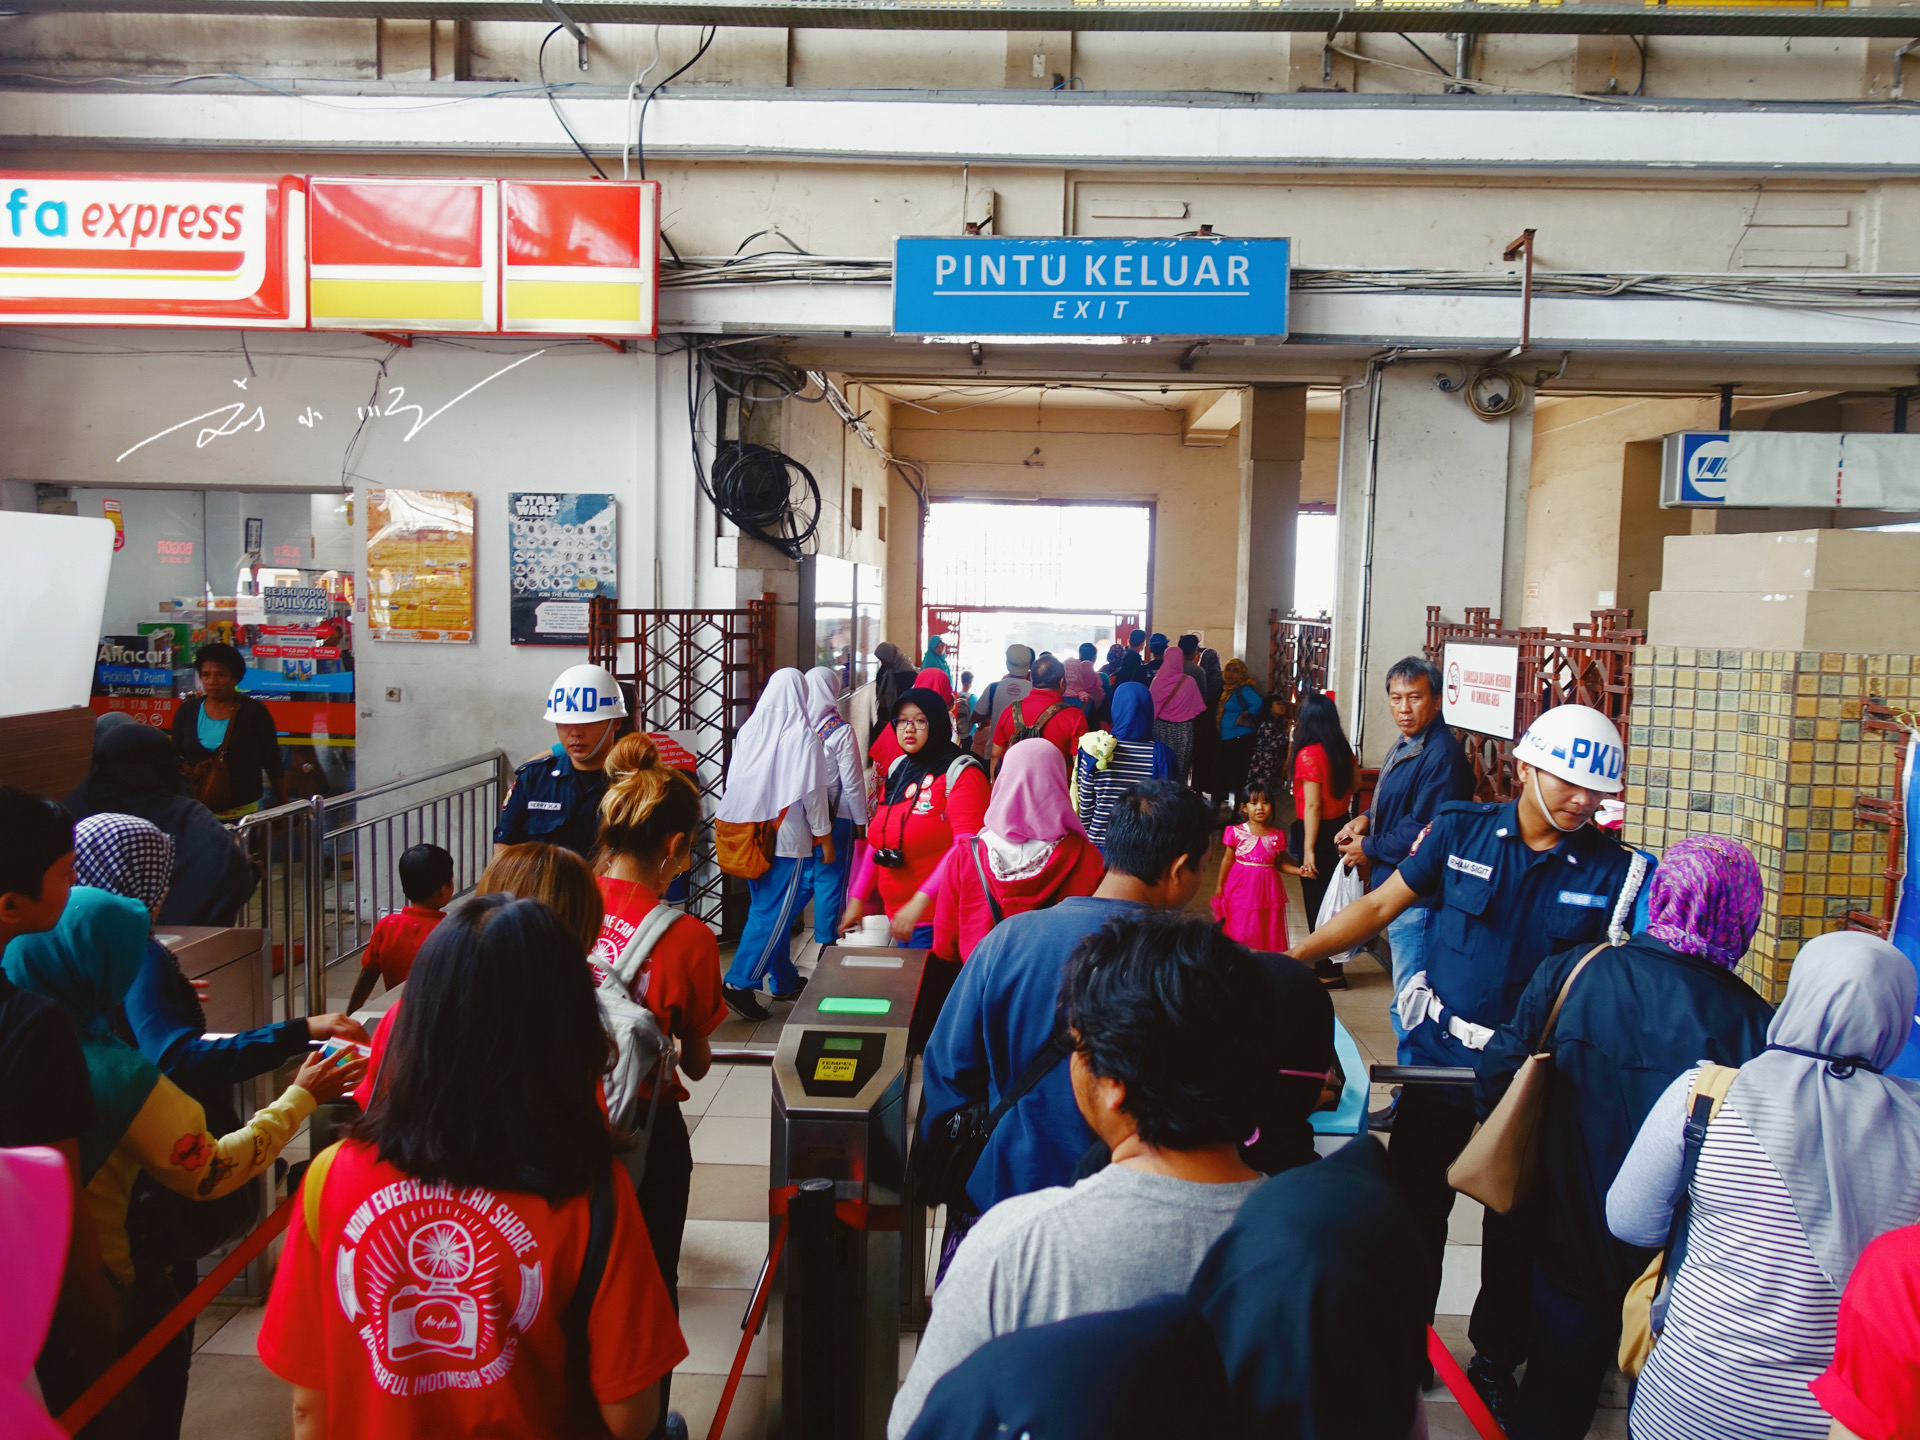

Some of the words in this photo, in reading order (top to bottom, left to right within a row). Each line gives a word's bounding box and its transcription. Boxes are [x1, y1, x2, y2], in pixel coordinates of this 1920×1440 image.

[81, 200, 244, 248] express
[936, 254, 1065, 287] PINTU
[1085, 254, 1252, 287] KELUAR
[1052, 300, 1131, 320] EXIT
[515, 495, 560, 506] STAR
[515, 505, 560, 517] WARS
[265, 587, 298, 598] REJEKI
[299, 588, 327, 598] WOW
[273, 597, 327, 610] MILYAR
[143, 672, 166, 683] Point
[553, 687, 598, 713] PKD
[1568, 737, 1623, 779] PKD
[614, 919, 637, 938] CAN
[343, 1200, 376, 1244] NOW
[488, 1203, 539, 1258] SHARE
[358, 1324, 410, 1397] WONDERFUL
[413, 1371, 482, 1397] INDONESIA
[481, 1337, 519, 1385] STORIES
